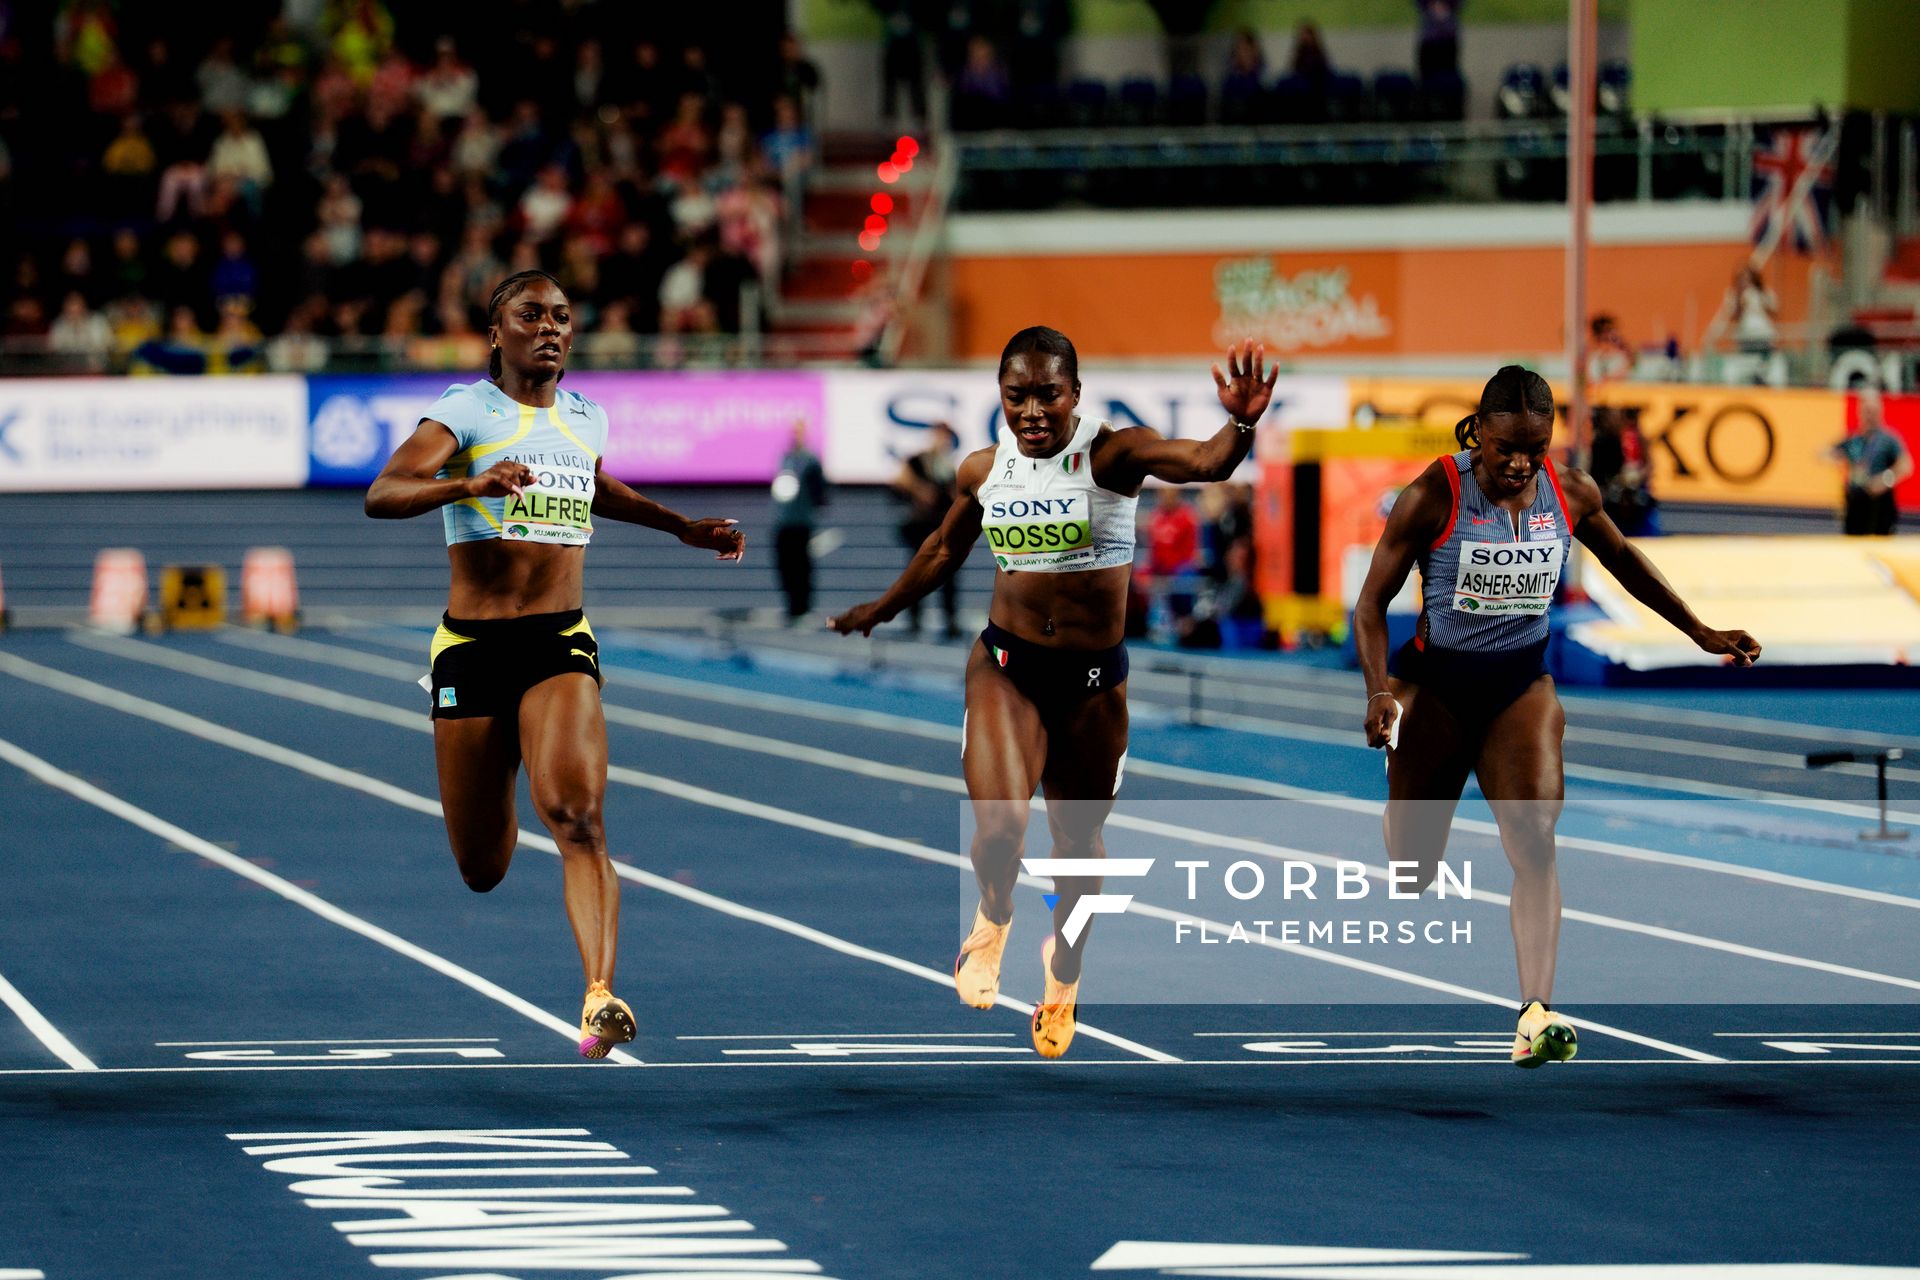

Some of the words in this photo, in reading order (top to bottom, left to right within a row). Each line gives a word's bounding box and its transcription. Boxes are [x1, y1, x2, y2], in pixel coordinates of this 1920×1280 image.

[511, 494, 590, 523] ALFRED
[991, 498, 1077, 519] SONY
[988, 522, 1084, 549] DOSSO
[1012, 559, 1041, 567] KUJAWY
[1042, 553, 1079, 566] POMORZE
[1470, 546, 1555, 566] SONY
[1460, 571, 1558, 596] ASHER-SMITH
[1513, 602, 1546, 610] POMORZE
